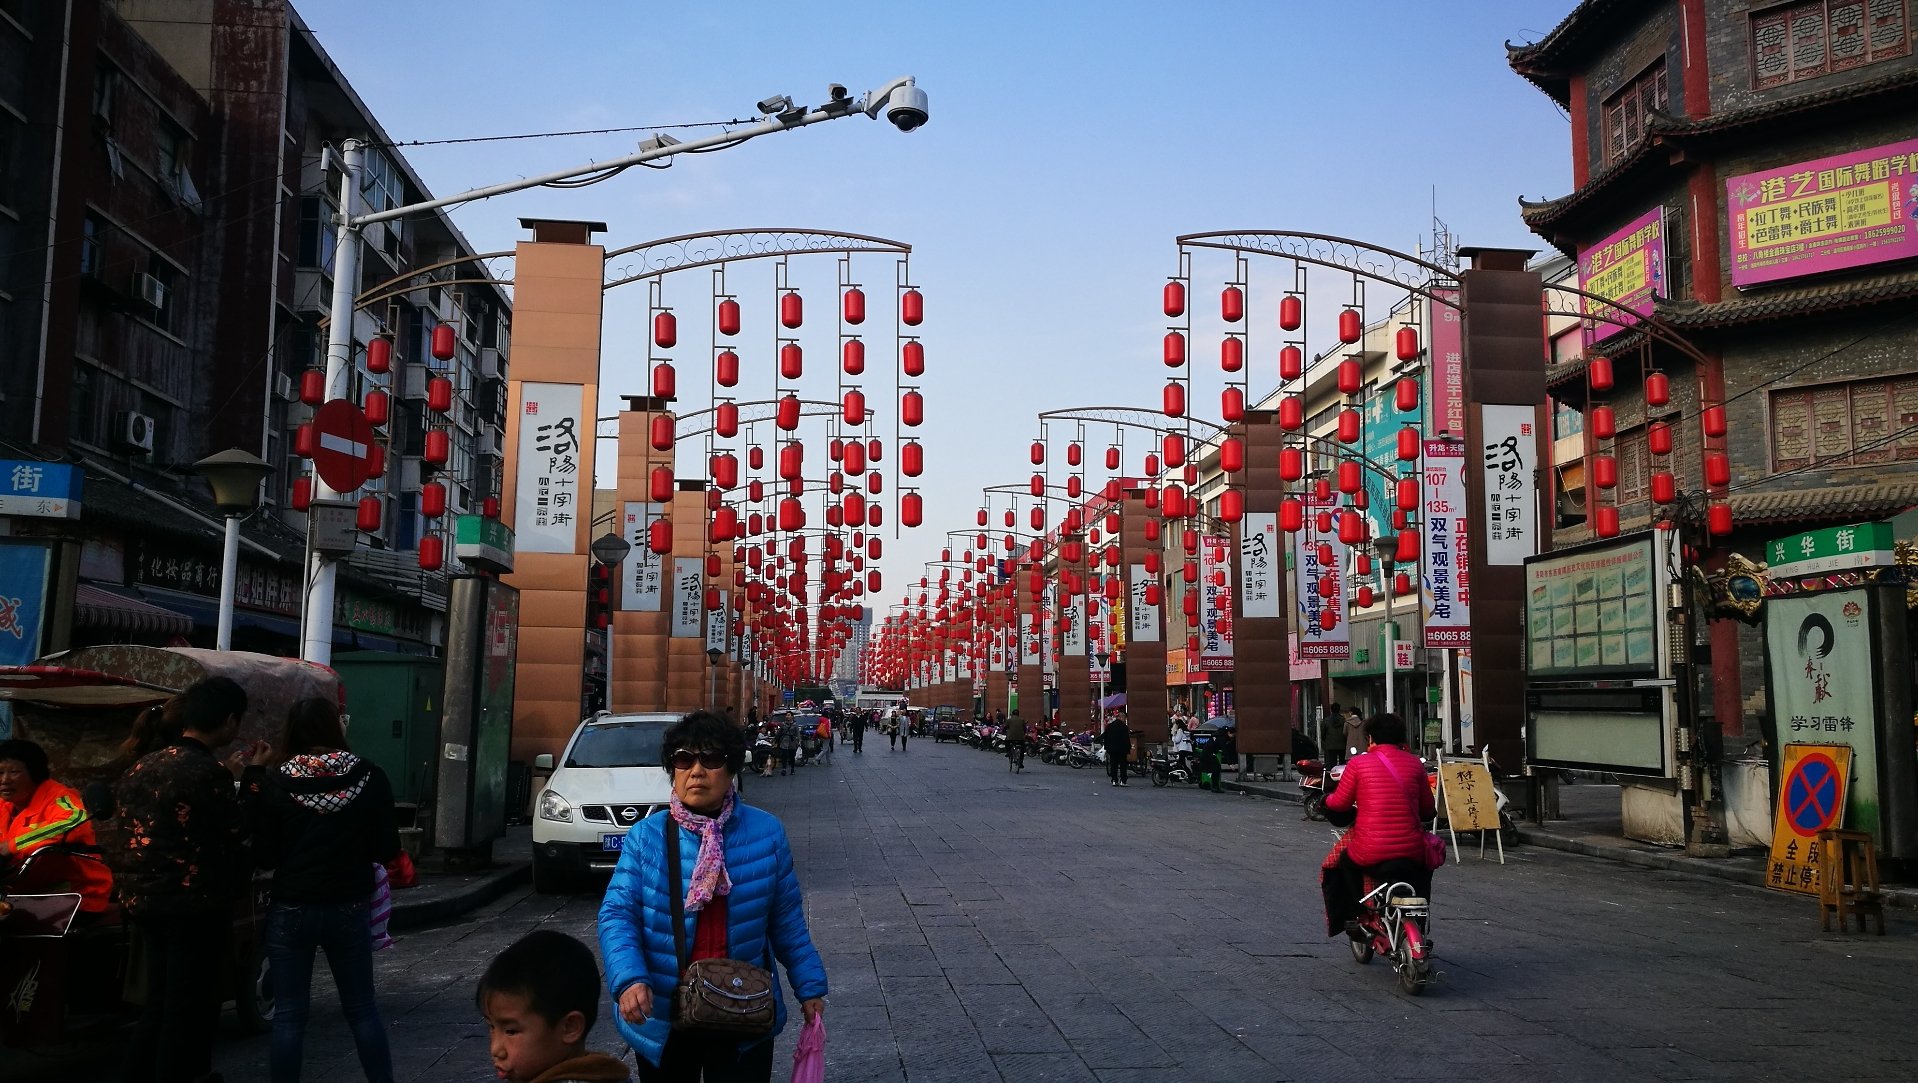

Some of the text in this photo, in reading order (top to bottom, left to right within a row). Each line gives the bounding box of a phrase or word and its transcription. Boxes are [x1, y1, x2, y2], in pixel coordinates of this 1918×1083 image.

[1754, 198, 1838, 227] 拉丁舞 民族舞
[1755, 223, 1793, 244] 芭蕾舞
[1799, 215, 1839, 236] 爵士舞
[1445, 352, 1463, 431] 进店送千元红包
[11, 464, 43, 494] 街
[1426, 473, 1447, 486] 107
[1775, 529, 1855, 562] 兴华街
[1430, 517, 1451, 620] 双气观景美宅
[1807, 561, 1820, 570] HUA
[1828, 558, 1839, 568] JIE
[1308, 646, 1349, 654] 6065 8888
[1434, 631, 1458, 642] 6065
[1790, 715, 1857, 733] 学习雷锋
